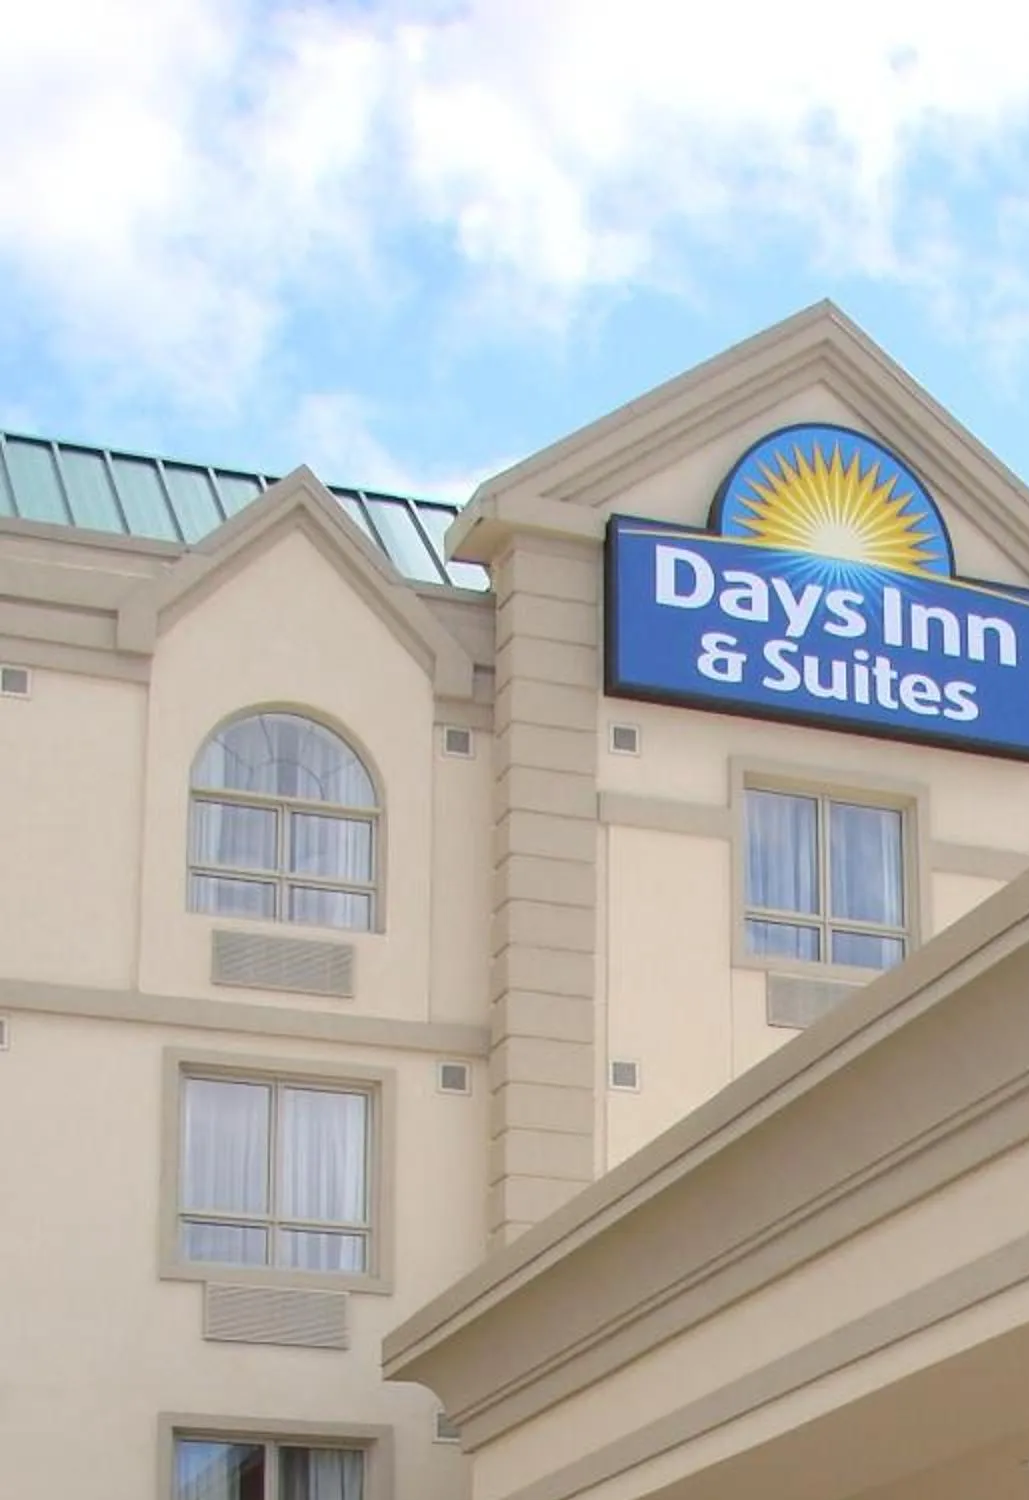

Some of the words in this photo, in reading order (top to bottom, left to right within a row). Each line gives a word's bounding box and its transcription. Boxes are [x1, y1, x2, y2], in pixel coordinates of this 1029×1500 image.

[655, 544, 867, 637] Days
[883, 587, 1017, 667] Inn
[697, 632, 748, 683] &
[762, 639, 980, 722] Suites
